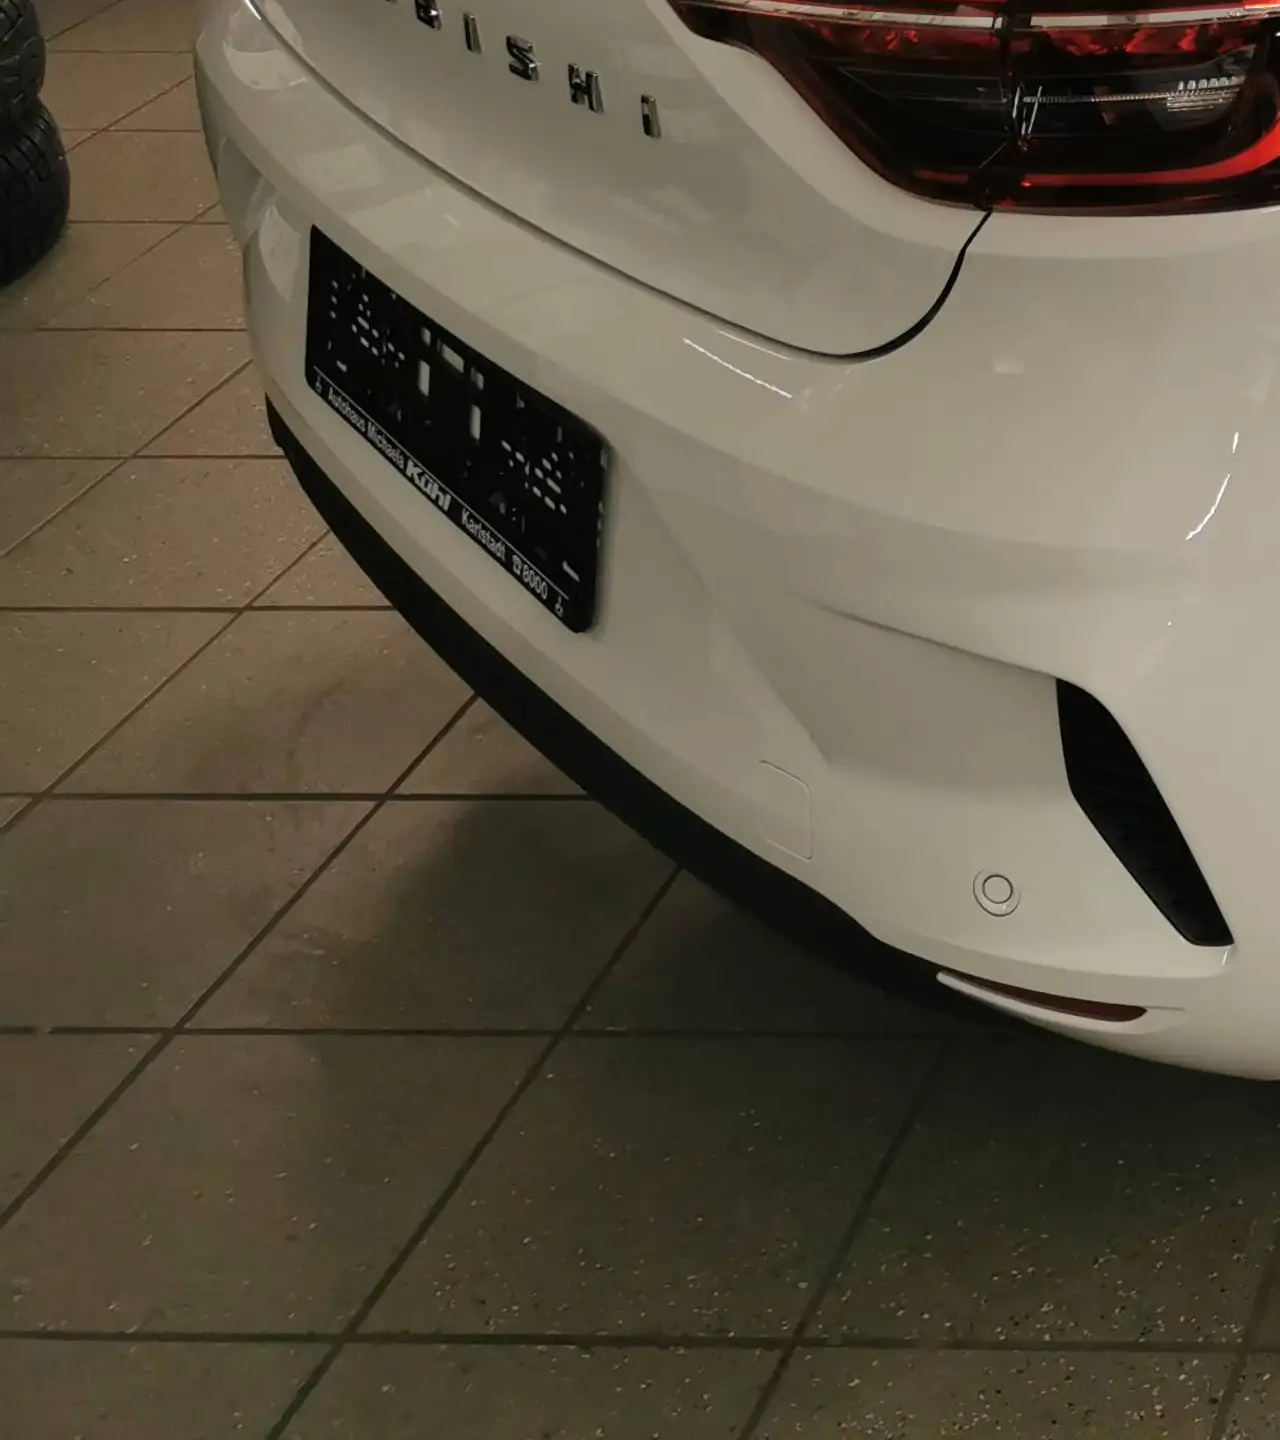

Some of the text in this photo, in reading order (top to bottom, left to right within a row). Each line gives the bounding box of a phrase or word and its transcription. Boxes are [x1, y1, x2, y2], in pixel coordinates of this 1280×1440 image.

[328, 386, 367, 433] Autohaus
[366, 421, 405, 470] Michaela
[405, 458, 452, 512] Kühl
[461, 508, 507, 562] Karlstadt
